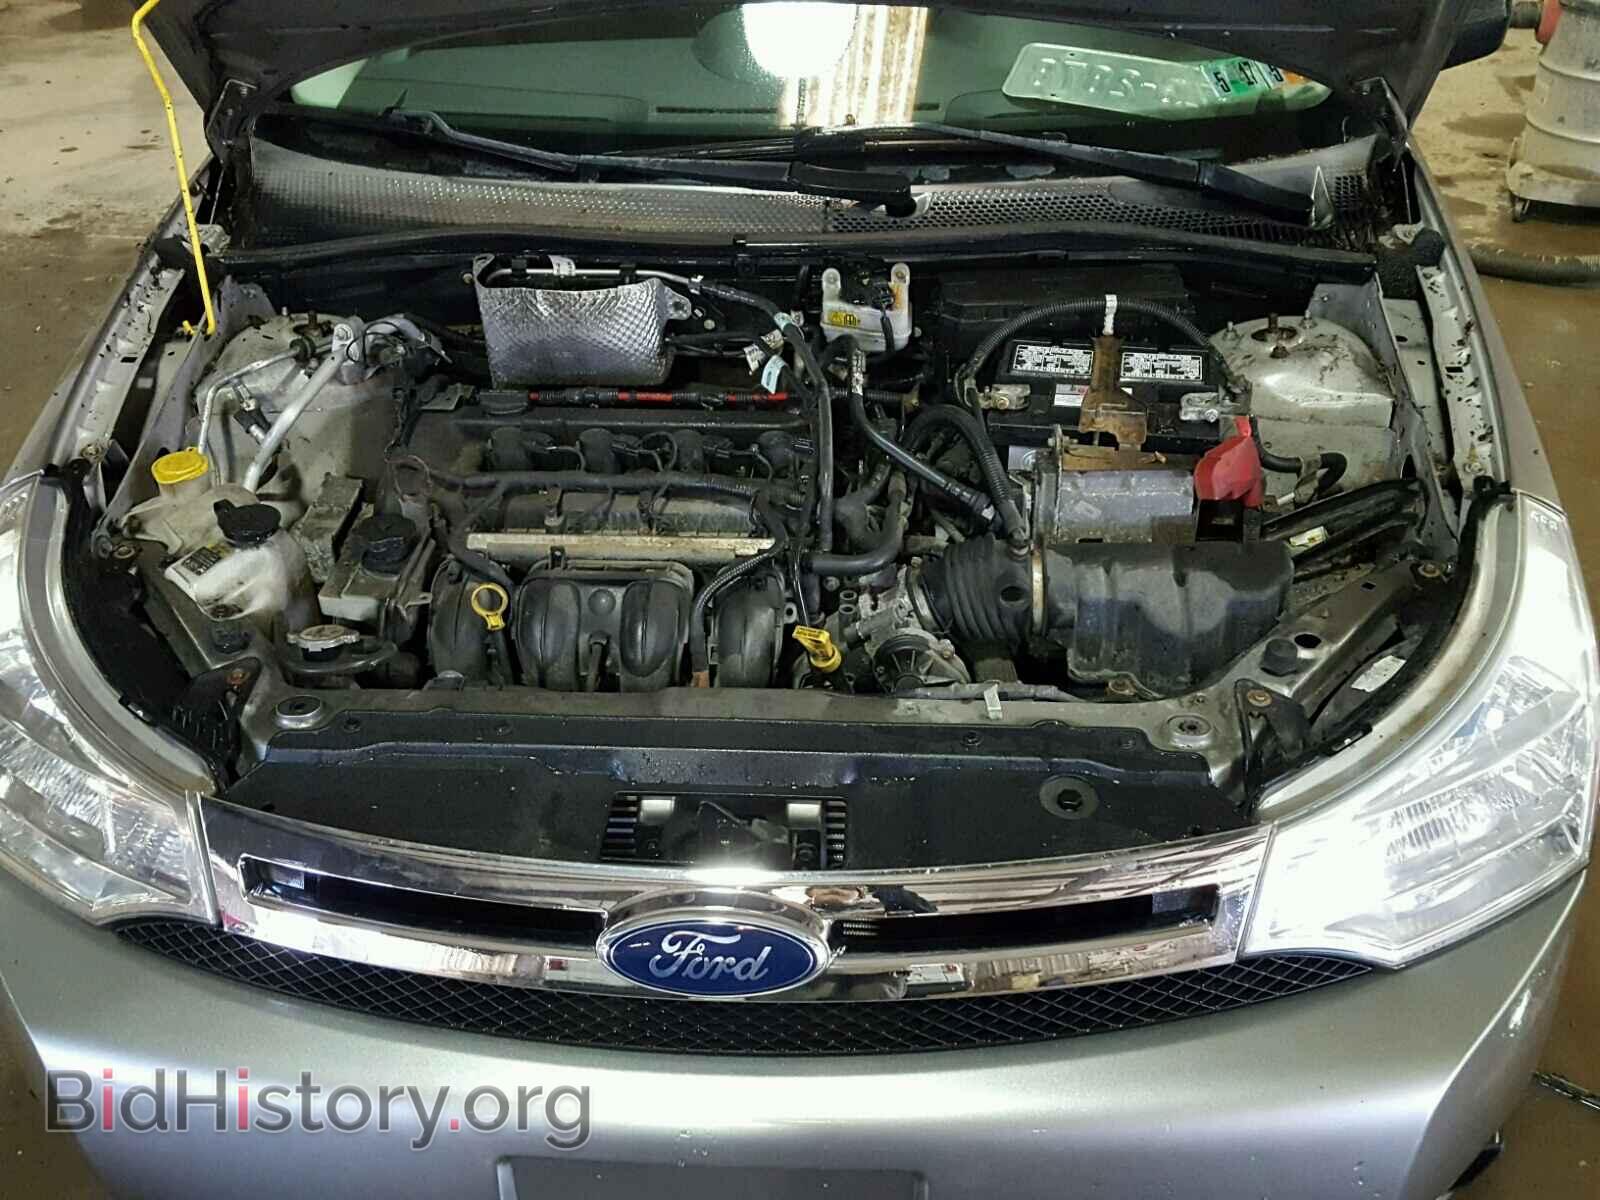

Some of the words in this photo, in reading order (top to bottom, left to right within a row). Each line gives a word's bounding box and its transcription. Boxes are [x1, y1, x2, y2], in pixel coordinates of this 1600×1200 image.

[1213, 71, 1231, 92] 5
[1238, 61, 1258, 86] 17
[648, 930, 772, 982] Ford
